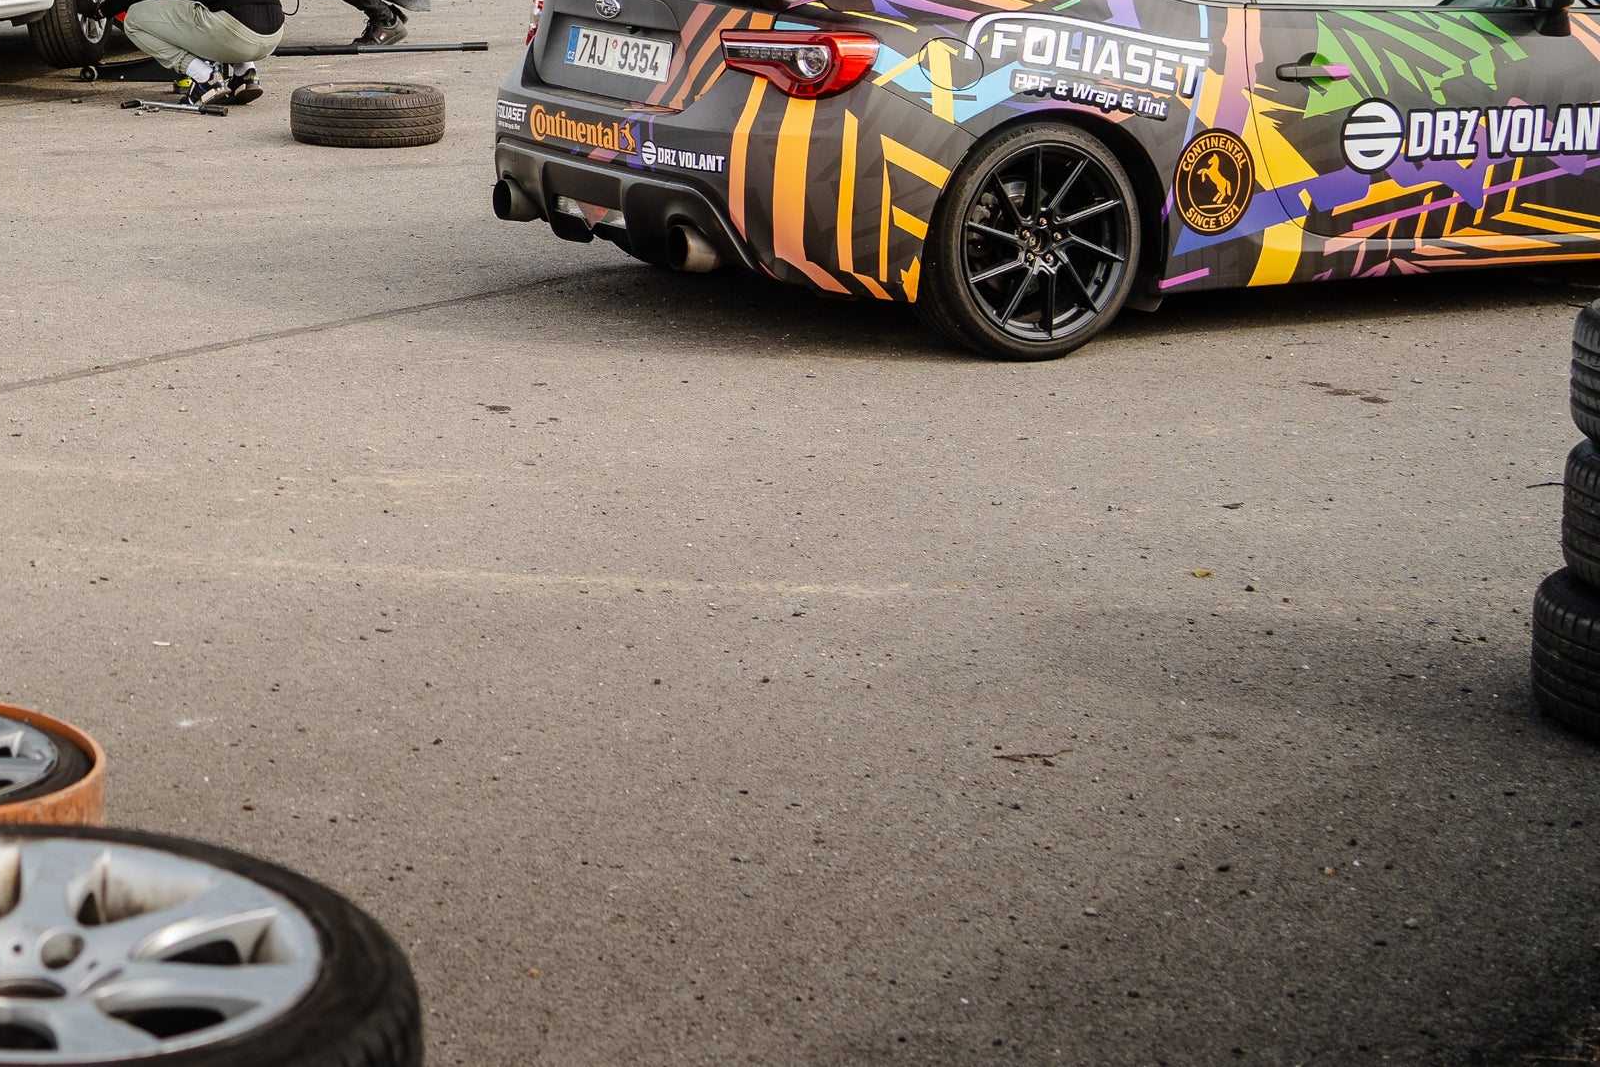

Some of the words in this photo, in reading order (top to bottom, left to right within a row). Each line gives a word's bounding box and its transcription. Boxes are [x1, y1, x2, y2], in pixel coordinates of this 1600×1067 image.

[567, 50, 576, 60] CZ
[578, 34, 609, 65] 7AJ
[618, 41, 660, 76] 9354
[990, 23, 1206, 95] FOLIASET
[1014, 73, 1052, 92] PPF
[1055, 80, 1069, 95] &
[1072, 82, 1118, 109] Wrap
[1121, 94, 1135, 110] &
[1137, 95, 1167, 117] Tint
[530, 104, 619, 151] Continental
[1408, 109, 1480, 157] DRZ
[657, 147, 677, 166] DRZ
[678, 150, 725, 172] VOLANT
[1182, 136, 1247, 172] CONTINENTAL
[1186, 207, 1216, 228] SINCE
[1218, 204, 1240, 226] 1871
